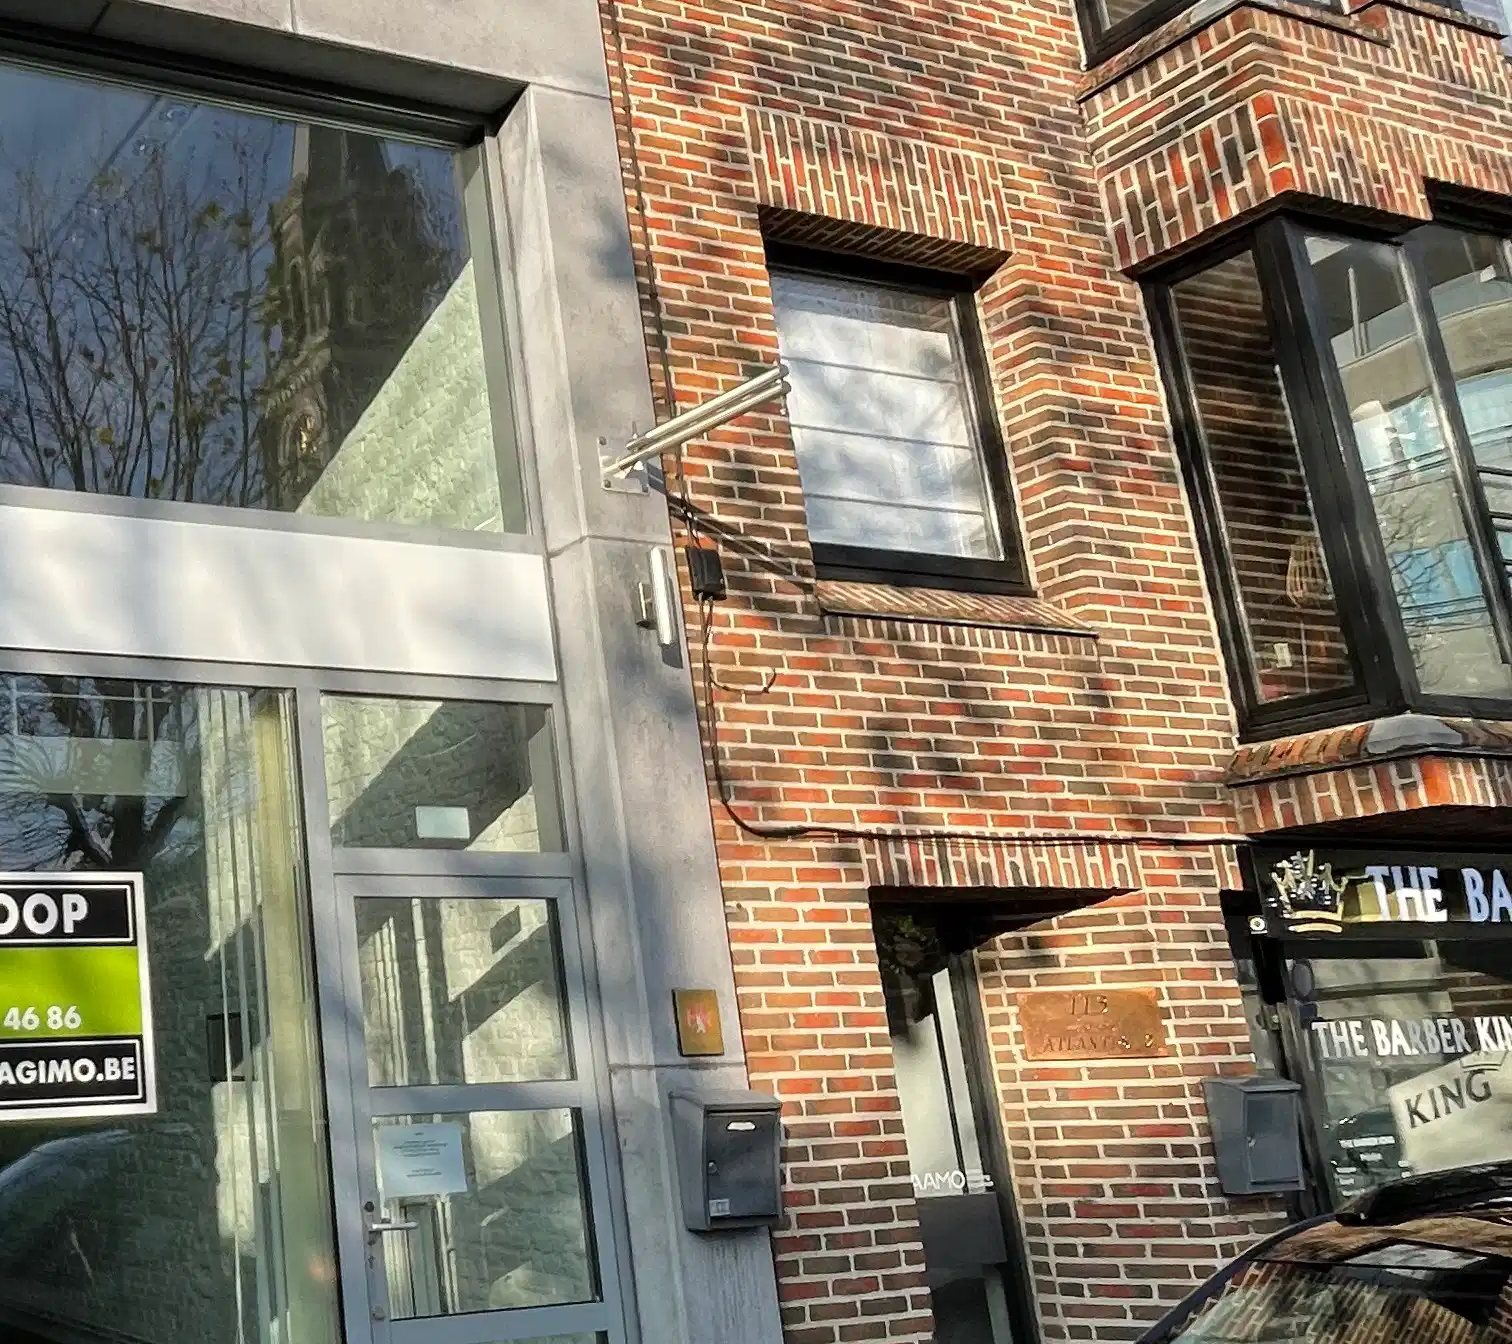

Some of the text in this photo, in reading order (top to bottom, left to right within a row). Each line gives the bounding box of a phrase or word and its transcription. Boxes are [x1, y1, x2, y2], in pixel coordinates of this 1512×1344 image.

[1365, 865, 1448, 922] THE
[3, 1005, 40, 1031] 46
[46, 1004, 82, 1031] 86
[1311, 1020, 1369, 1059] THE
[1370, 1017, 1472, 1057] BARBER
[1404, 1069, 1493, 1129] KING
